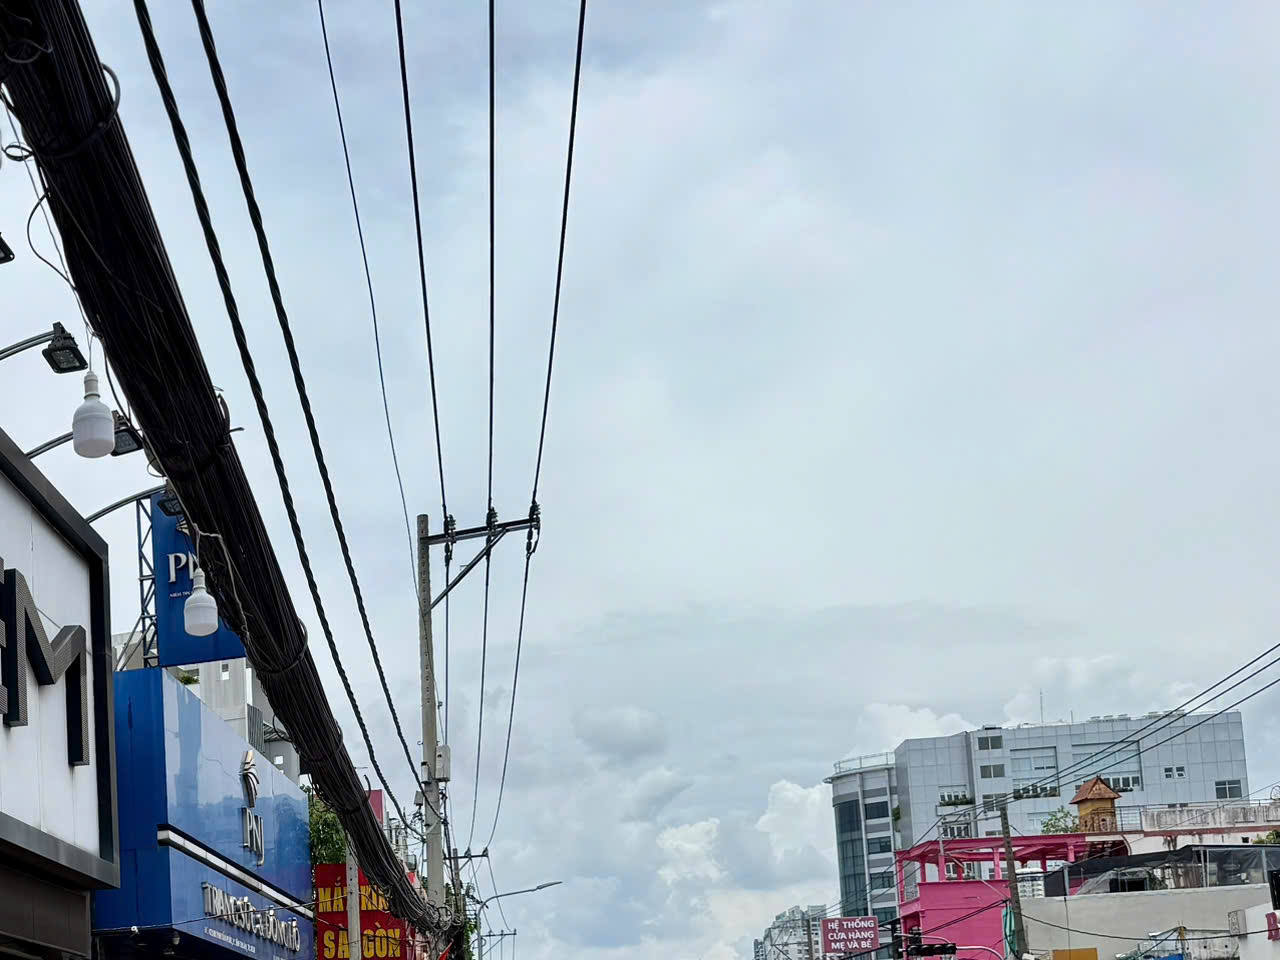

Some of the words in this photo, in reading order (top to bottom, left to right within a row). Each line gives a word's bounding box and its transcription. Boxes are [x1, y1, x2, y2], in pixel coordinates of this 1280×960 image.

[241, 806, 265, 866] PNJ
[318, 876, 348, 912] MẮ
[828, 920, 839, 933] HỆ
[843, 917, 874, 929] THỐNG
[849, 930, 874, 939] HÀNG
[323, 923, 350, 959] SÀ
[362, 921, 401, 958] GÒN
[832, 942, 845, 951] MẸ
[847, 940, 859, 949] VÀ
[861, 939, 872, 948] BÉ
